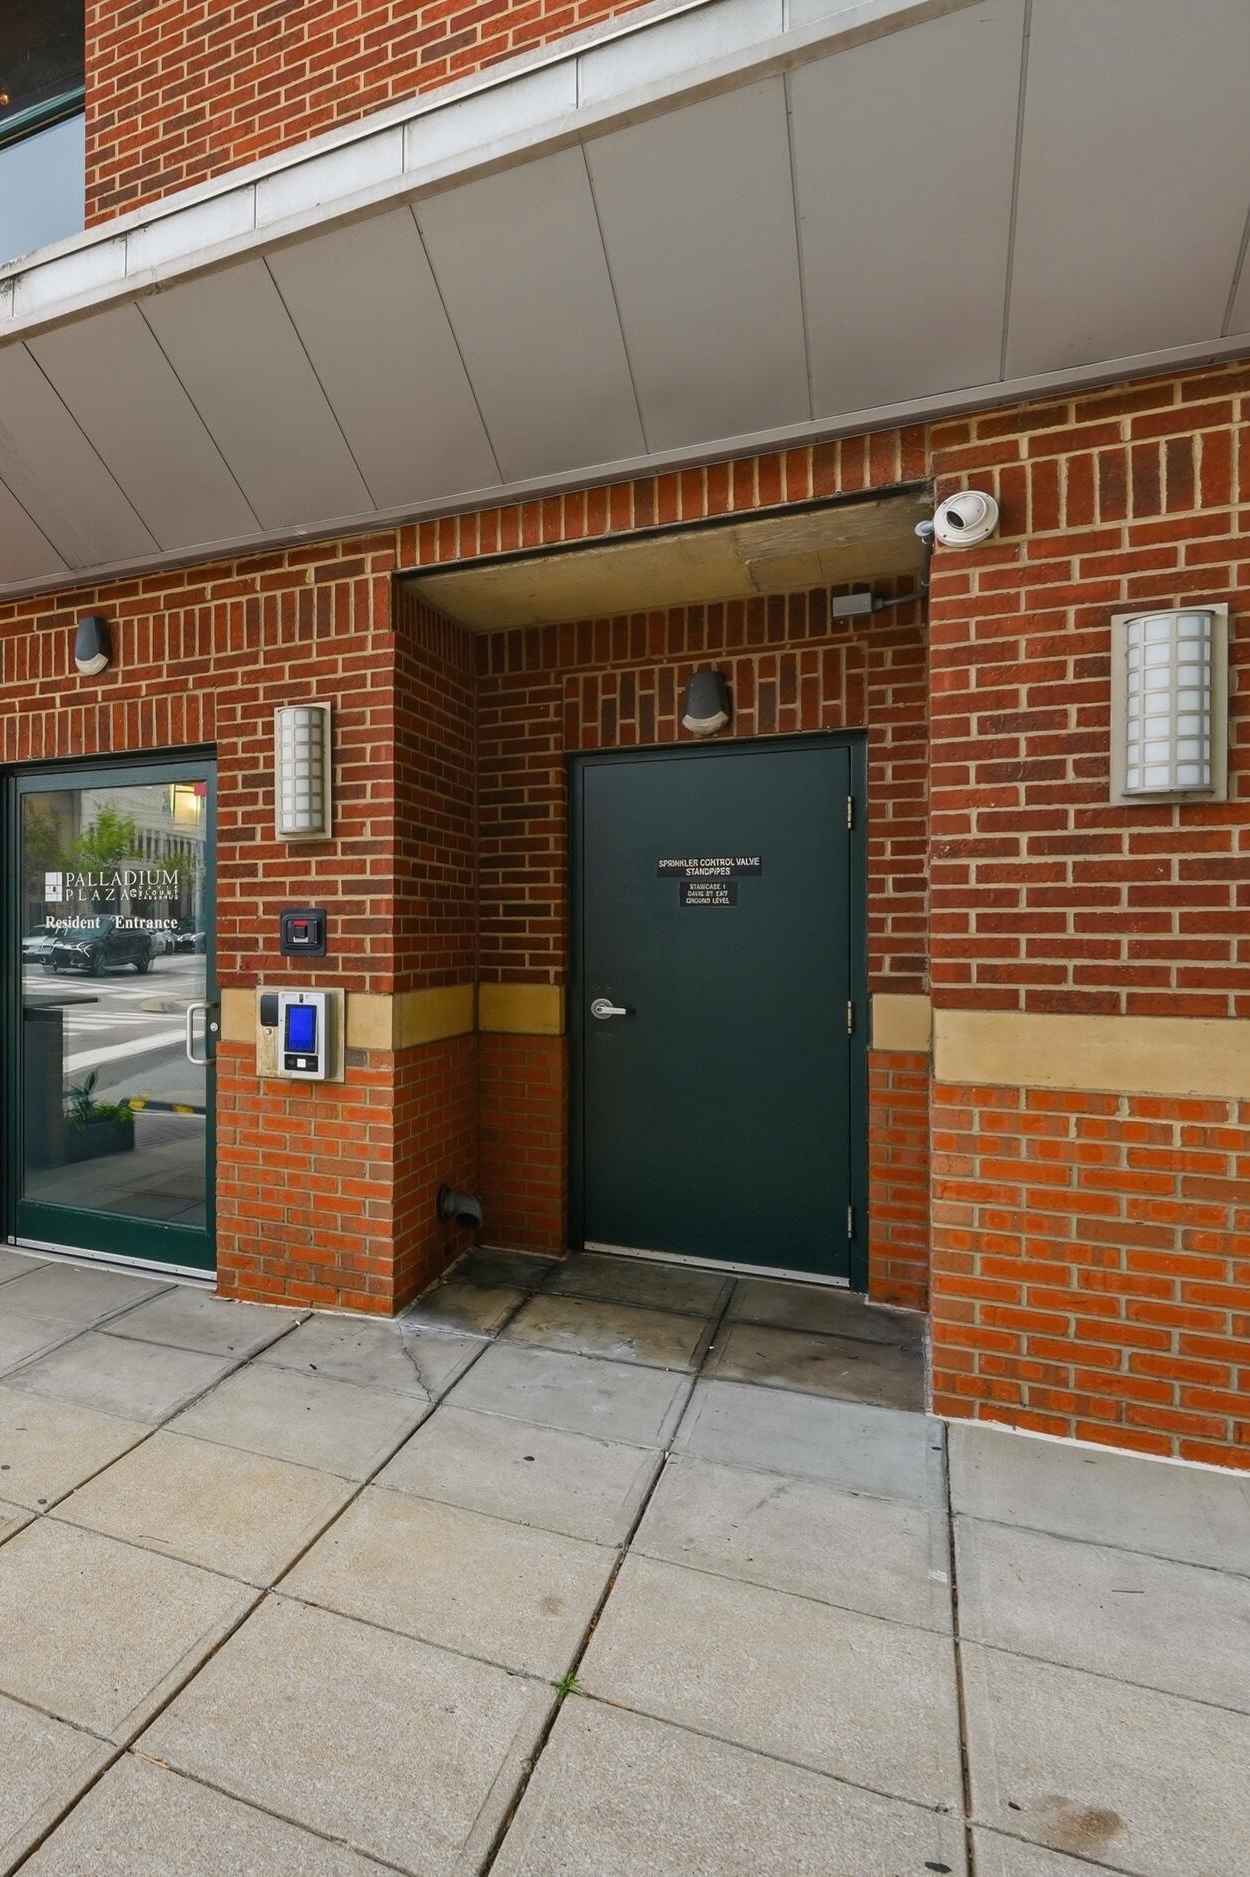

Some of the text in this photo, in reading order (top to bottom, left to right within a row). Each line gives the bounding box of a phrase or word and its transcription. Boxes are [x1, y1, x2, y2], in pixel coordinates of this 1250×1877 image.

[658, 857, 760, 868] SPRINKLER CONTROL VALVE
[686, 867, 731, 876] STANDPIPES
[66, 870, 179, 887] PALLADIUM
[66, 888, 130, 901] PLAZA
[45, 915, 178, 929] Resident Entrance
